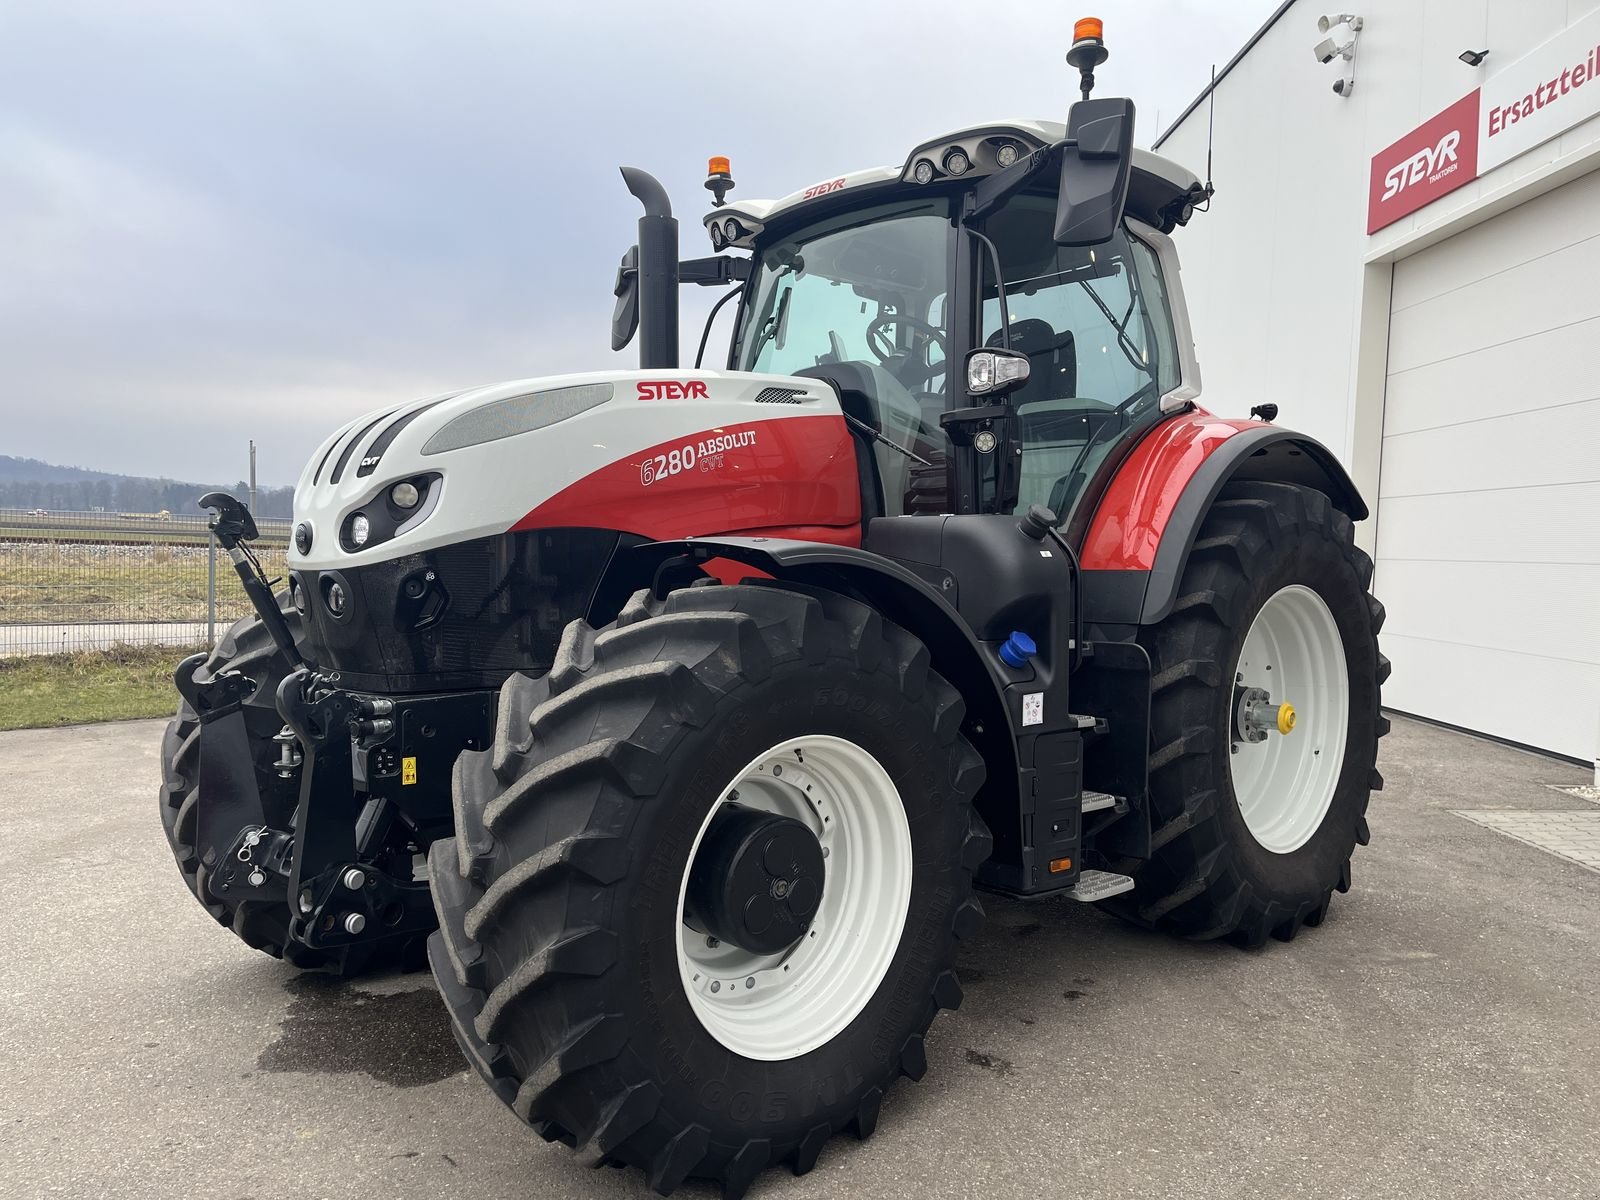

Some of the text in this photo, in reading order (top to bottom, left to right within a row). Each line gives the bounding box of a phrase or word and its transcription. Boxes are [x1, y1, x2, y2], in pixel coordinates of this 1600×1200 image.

[1381, 129, 1461, 202] STEYR
[1429, 163, 1458, 184] TRAKTOREN
[803, 178, 846, 200] STEYR
[637, 381, 709, 400] STEYR
[361, 456, 380, 466] CVT
[641, 431, 756, 486] 6280 ABSOLUT
[700, 455, 724, 473] CVT
